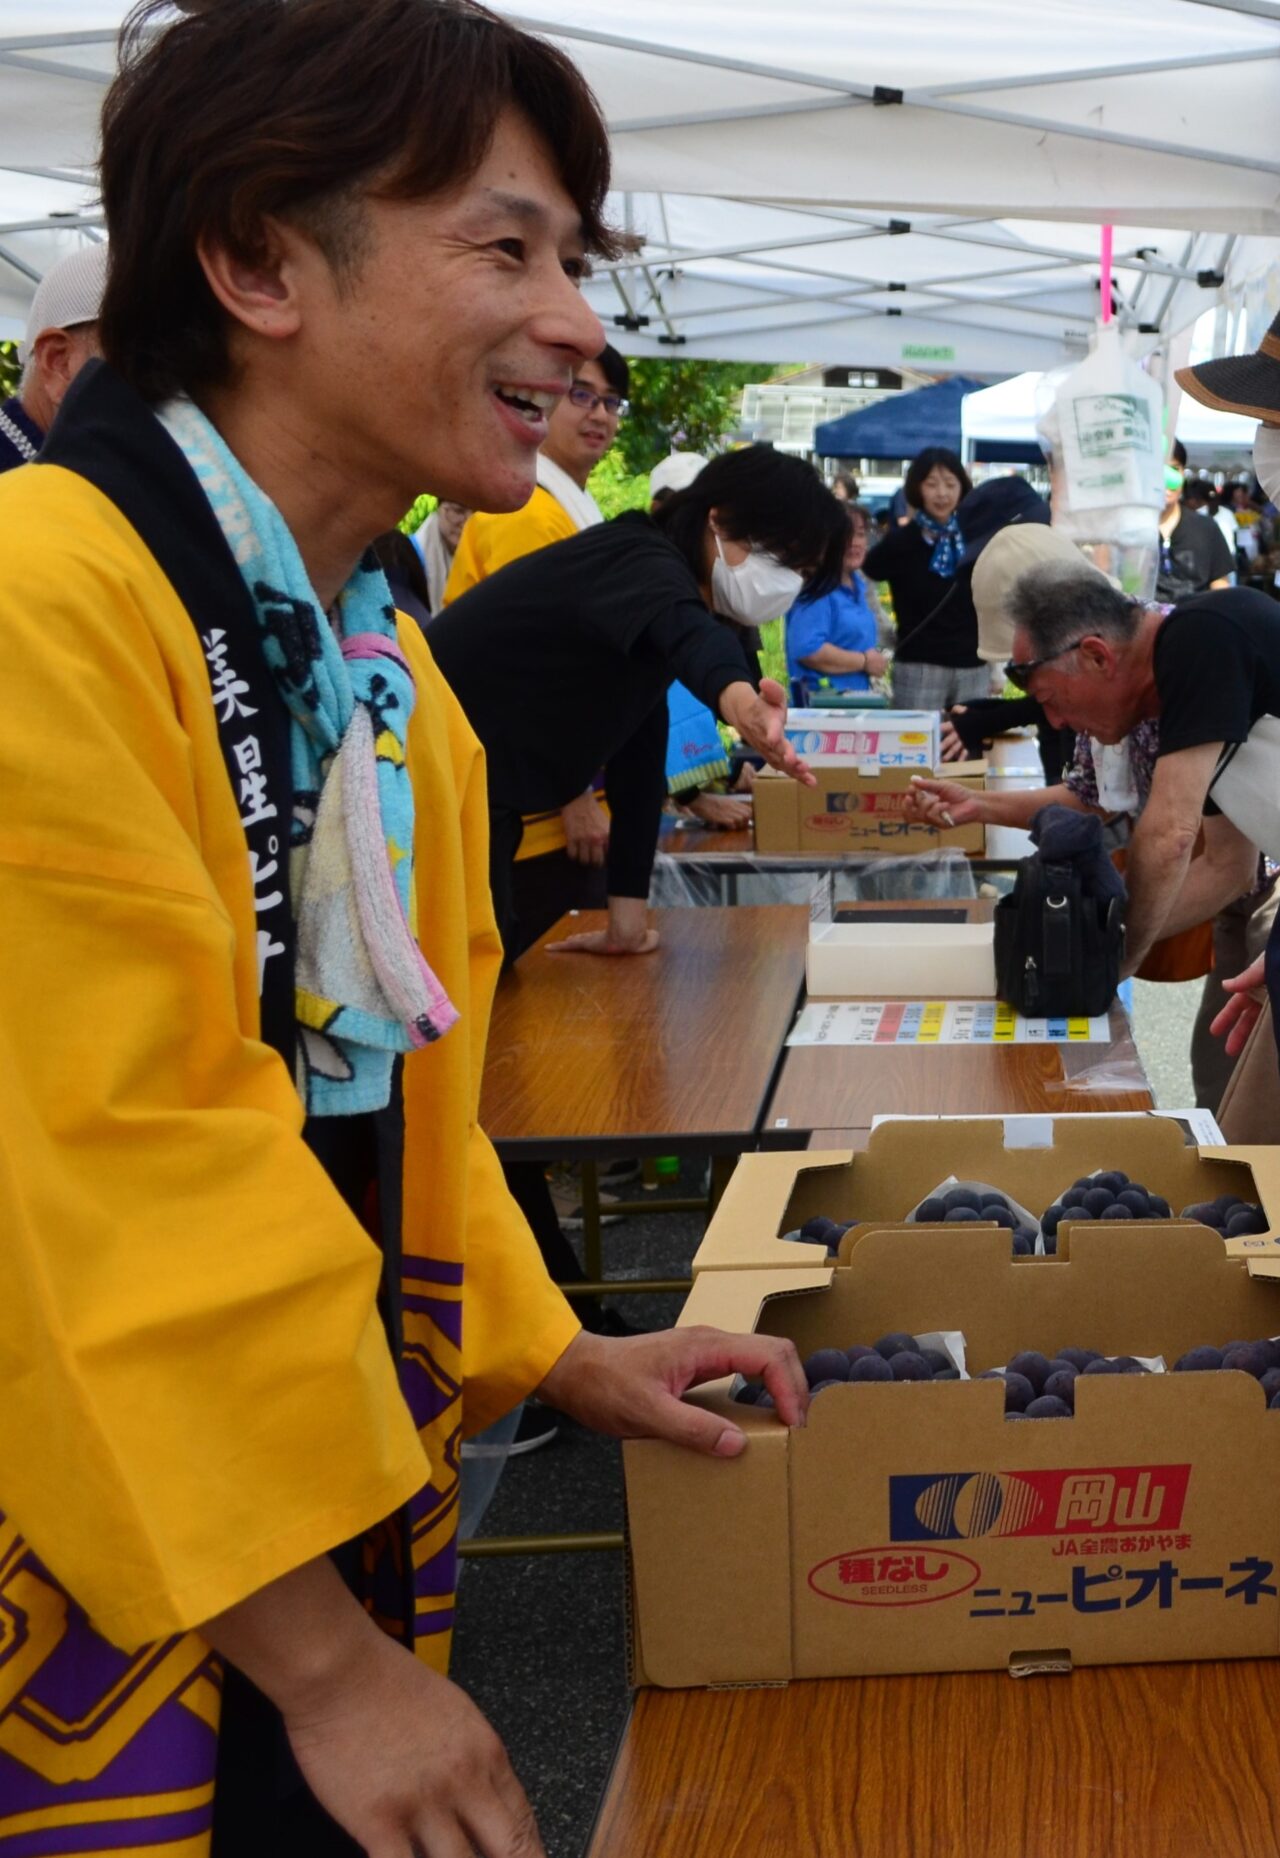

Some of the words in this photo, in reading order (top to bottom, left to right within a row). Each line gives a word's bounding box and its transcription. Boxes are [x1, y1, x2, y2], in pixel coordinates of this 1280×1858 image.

[1055, 1470, 1166, 1529] 岡山
[838, 1555, 950, 1584] 種なし
[861, 1584, 928, 1595] SEEDLESS
[969, 1556, 1278, 1618] ニューピオーネ
